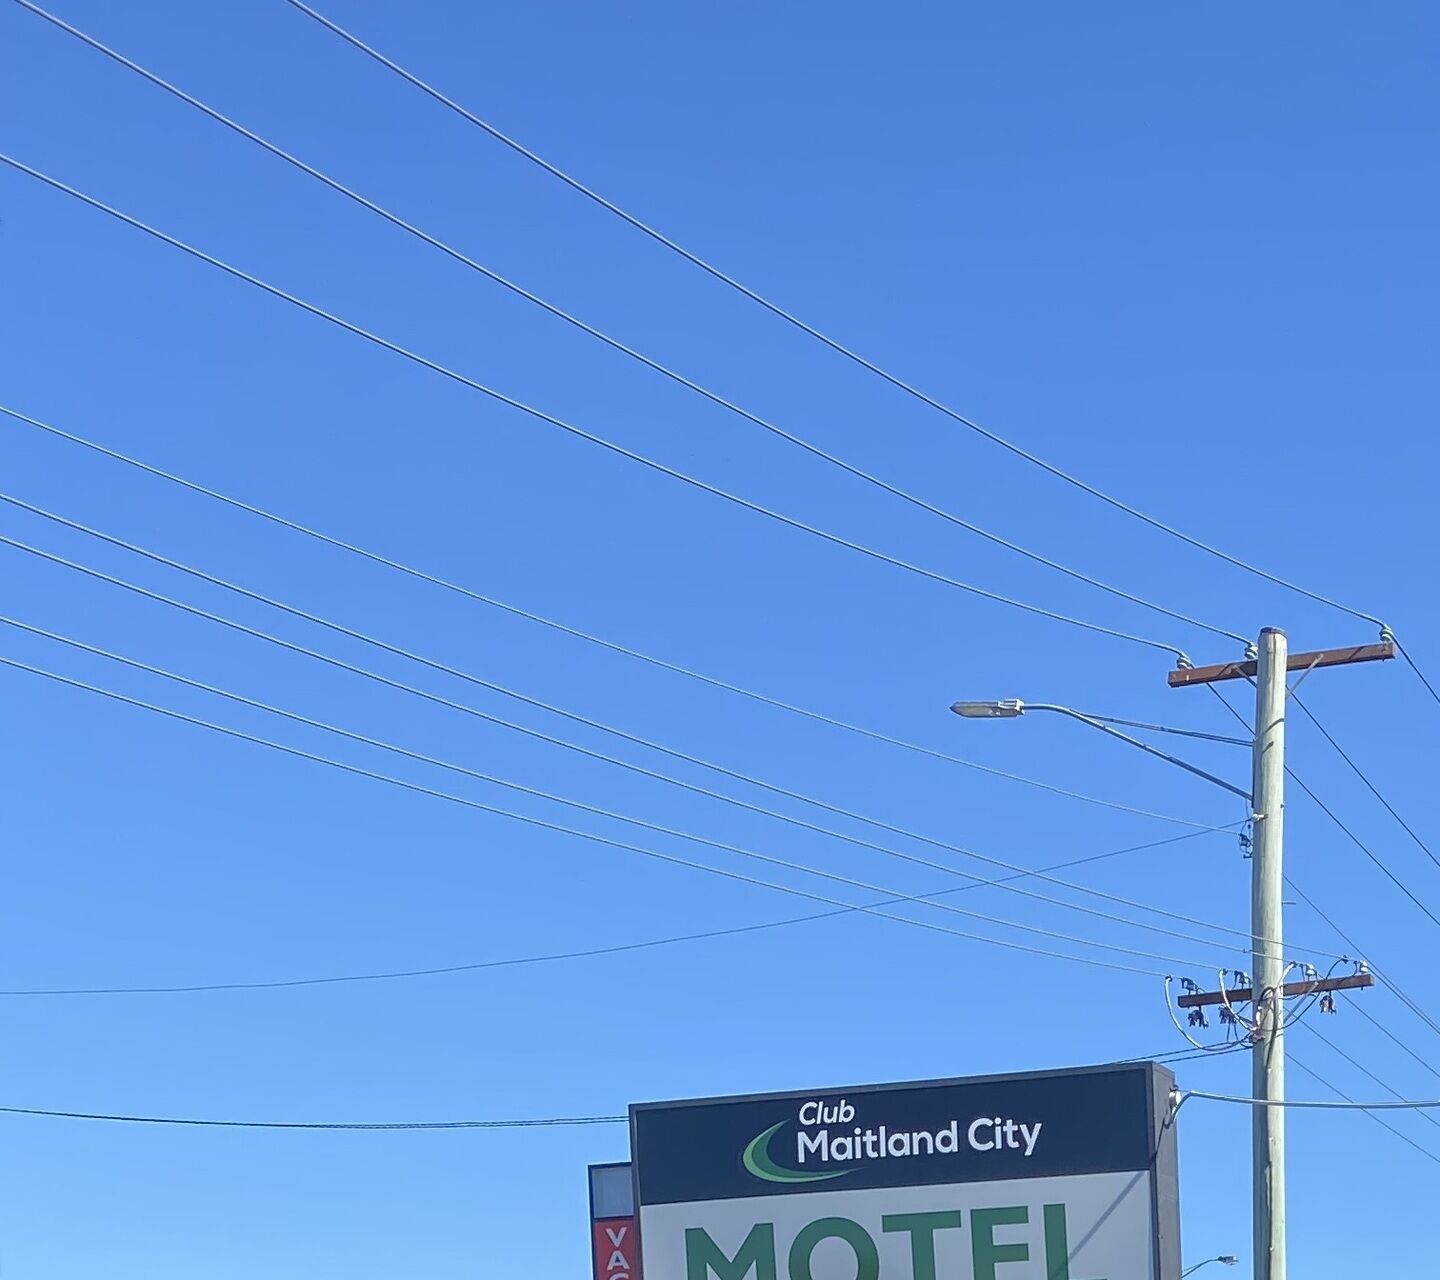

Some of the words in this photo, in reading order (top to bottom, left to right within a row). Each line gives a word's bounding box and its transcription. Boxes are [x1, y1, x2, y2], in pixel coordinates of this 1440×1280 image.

[798, 1099, 855, 1126] Club
[797, 1120, 959, 1163] Maitland
[968, 1117, 1042, 1156] City
